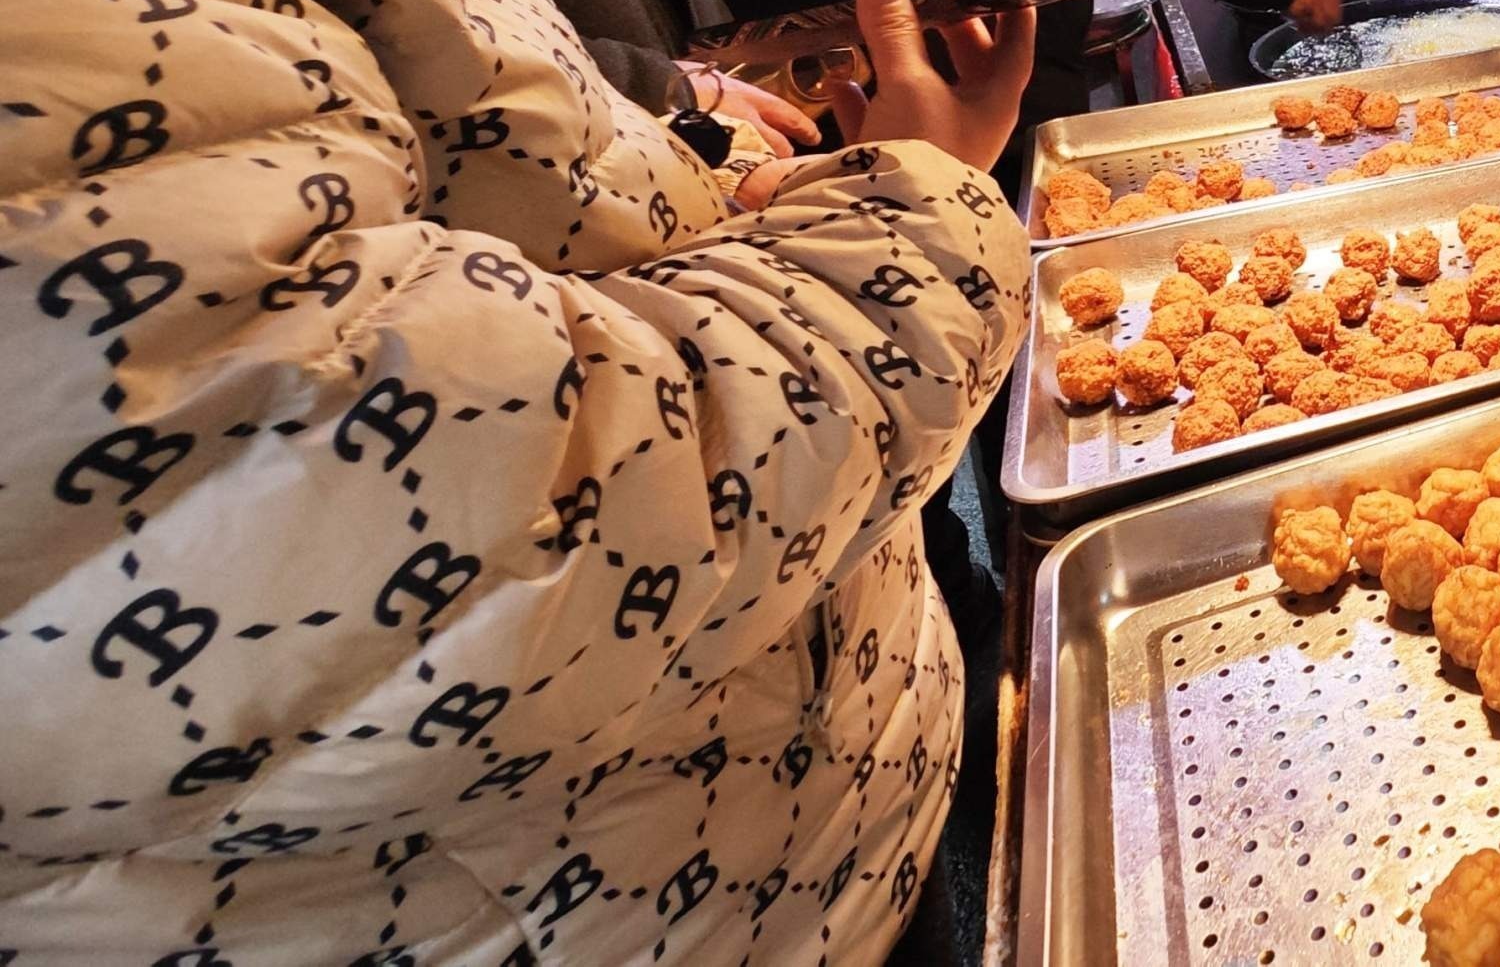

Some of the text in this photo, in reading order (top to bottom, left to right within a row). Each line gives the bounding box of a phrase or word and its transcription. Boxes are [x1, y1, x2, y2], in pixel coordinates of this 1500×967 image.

[70, 99, 170, 178] B
[430, 107, 509, 152] B
[298, 172, 355, 264] B
[648, 191, 678, 244] B
[957, 181, 996, 219] B
[37, 239, 186, 336] B
[462, 251, 533, 302] B
[860, 265, 924, 307] B
[954, 265, 1001, 311] B
[864, 340, 921, 390] B
[334, 377, 437, 472] B
[54, 425, 196, 505] B
[374, 541, 481, 625] B
[777, 524, 826, 584] B
[613, 564, 680, 640] B
[92, 588, 219, 687] B
[856, 628, 879, 685] B
[408, 682, 510, 748] B
[906, 734, 927, 791] B
[525, 853, 603, 928] B
[656, 849, 719, 926] B
